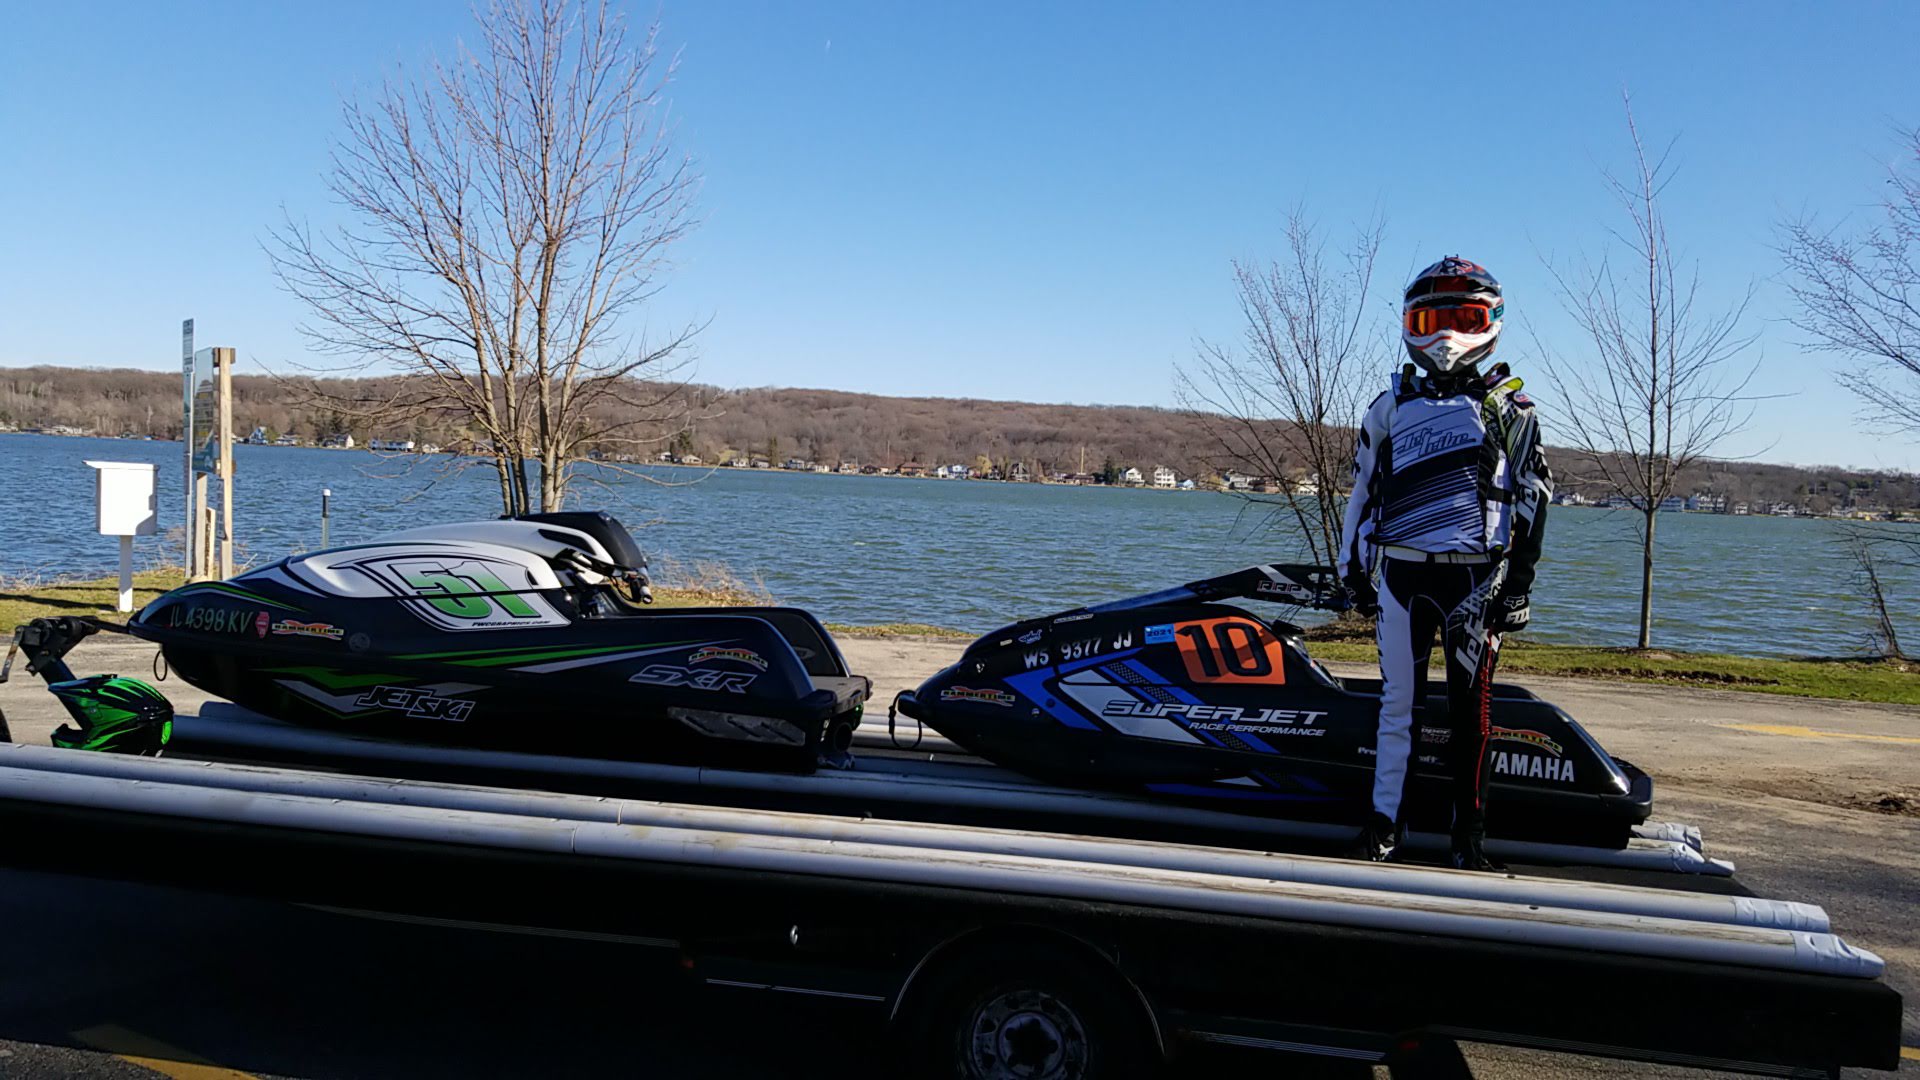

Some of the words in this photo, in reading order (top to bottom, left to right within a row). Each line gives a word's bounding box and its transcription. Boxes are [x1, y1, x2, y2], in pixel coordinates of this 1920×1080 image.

[387, 561, 542, 619] 51
[169, 606, 182, 627] IL
[185, 608, 225, 632] 4398
[227, 610, 254, 634] KV
[274, 623, 342, 635] HAMMERTIME
[1146, 628, 1172, 637] 2021
[1023, 651, 1050, 669] WS
[1061, 638, 1103, 661] 9377
[1113, 631, 1132, 650] JJ
[1175, 622, 1273, 677] 10
[943, 689, 1015, 701] HAMMERTIME
[1188, 722, 1226, 732] RACE
[1226, 724, 1327, 737] PERFORMANCE
